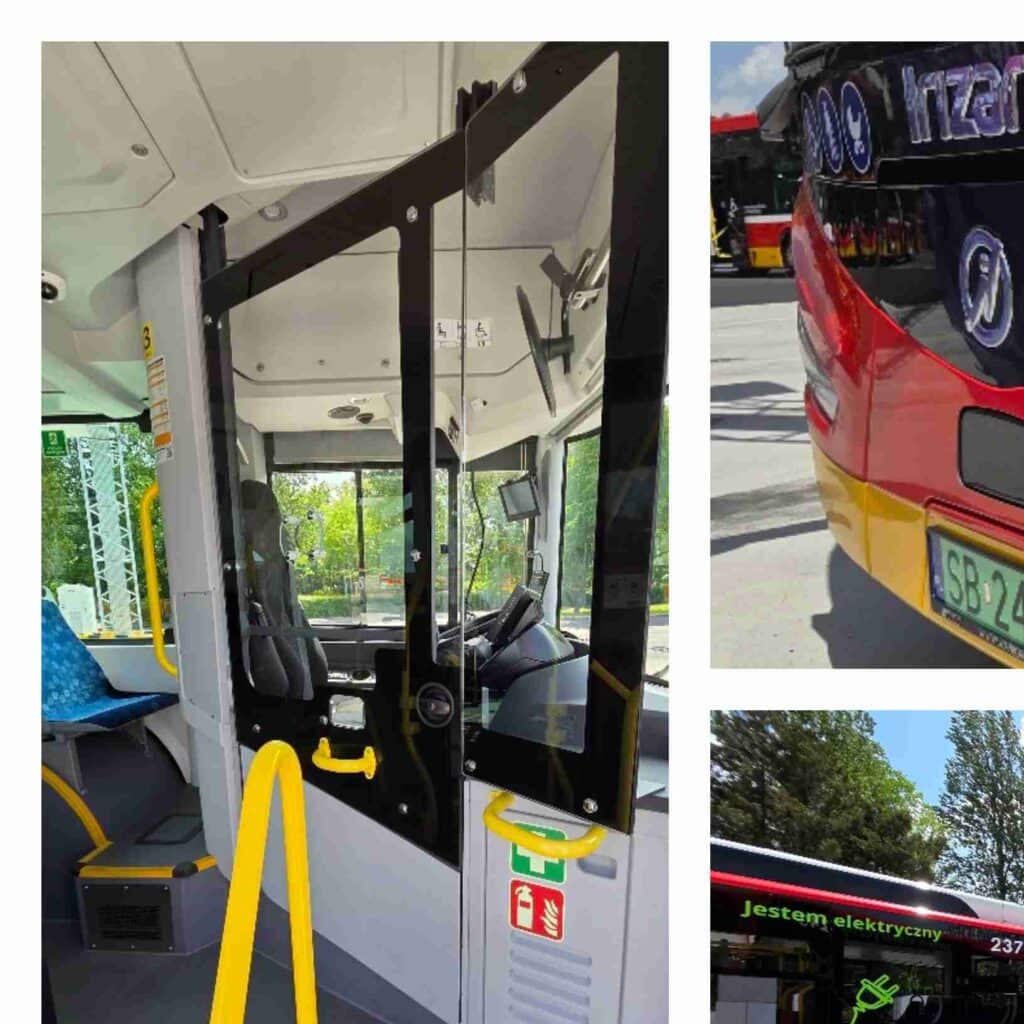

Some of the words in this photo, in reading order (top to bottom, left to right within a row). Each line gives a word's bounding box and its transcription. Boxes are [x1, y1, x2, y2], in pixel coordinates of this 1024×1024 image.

[947, 550, 981, 615] SB
[740, 900, 827, 926] Jestem
[833, 914, 943, 943] elektryczny
[990, 937, 1024, 956] 237
